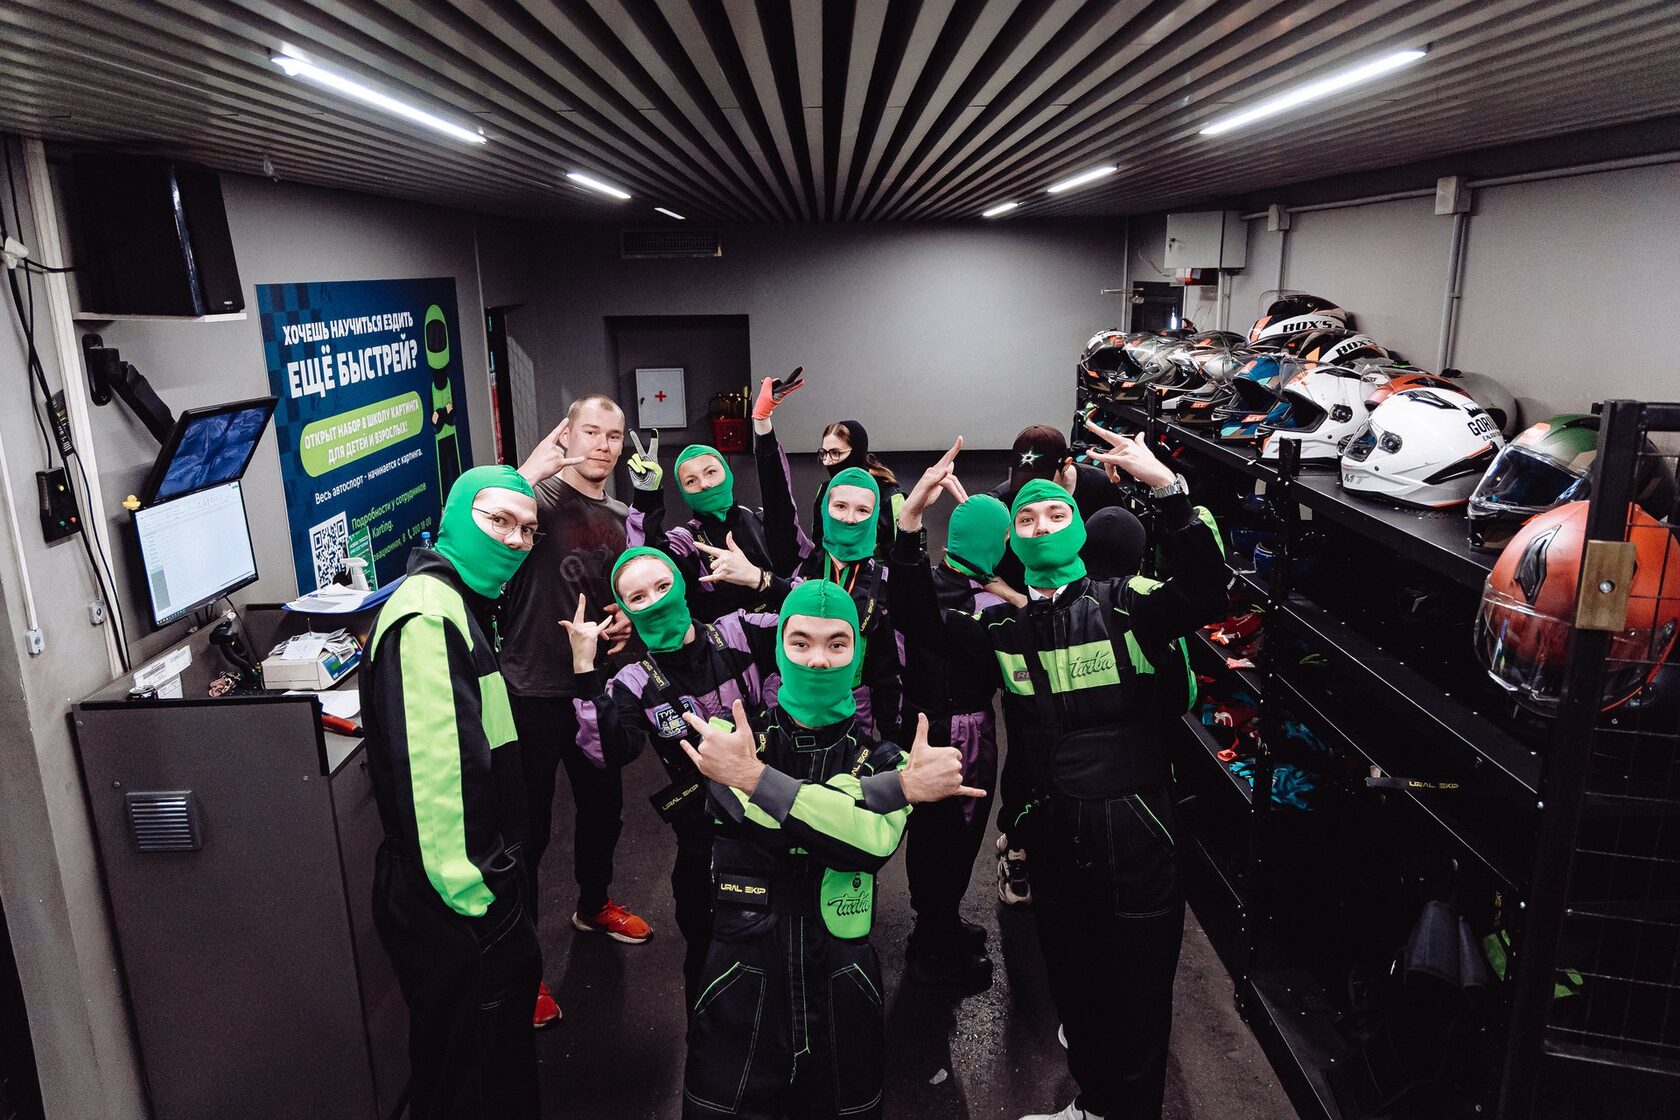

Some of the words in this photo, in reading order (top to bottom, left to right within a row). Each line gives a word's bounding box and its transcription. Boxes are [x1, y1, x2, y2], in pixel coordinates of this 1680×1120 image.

[282, 321, 329, 346] ХОЧЕШЬ
[330, 315, 381, 339] НАУЧИТЬСЯ
[383, 311, 413, 332] ЕЗДИТЬ
[1282, 320, 1333, 332] BOX'S
[287, 344, 336, 399] ЕЩЁ
[336, 333, 418, 387] БЫСТРЕЙ?
[304, 427, 338, 450] ОТКРЫТ
[338, 418, 361, 437] НАБОР
[361, 416, 367, 429] В
[367, 409, 390, 428] ШКОЛУ
[390, 399, 419, 418] КАРТИНГА
[328, 445, 346, 466] ДЛЯ
[345, 433, 369, 459] ДЕТЕЙ
[369, 433, 375, 446] И
[375, 421, 409, 444] ВЗРОСЛЫХ!
[315, 492, 332, 505] Весь
[332, 474, 364, 498] автоспорт
[367, 459, 397, 481] начинается
[397, 457, 401, 467] с
[351, 502, 391, 531] Подробности
[391, 500, 396, 511] у
[658, 702, 690, 719] ТУРР
[1408, 780, 1436, 789] URAL
[662, 797, 683, 811] URAL
[720, 883, 743, 893] URAL
